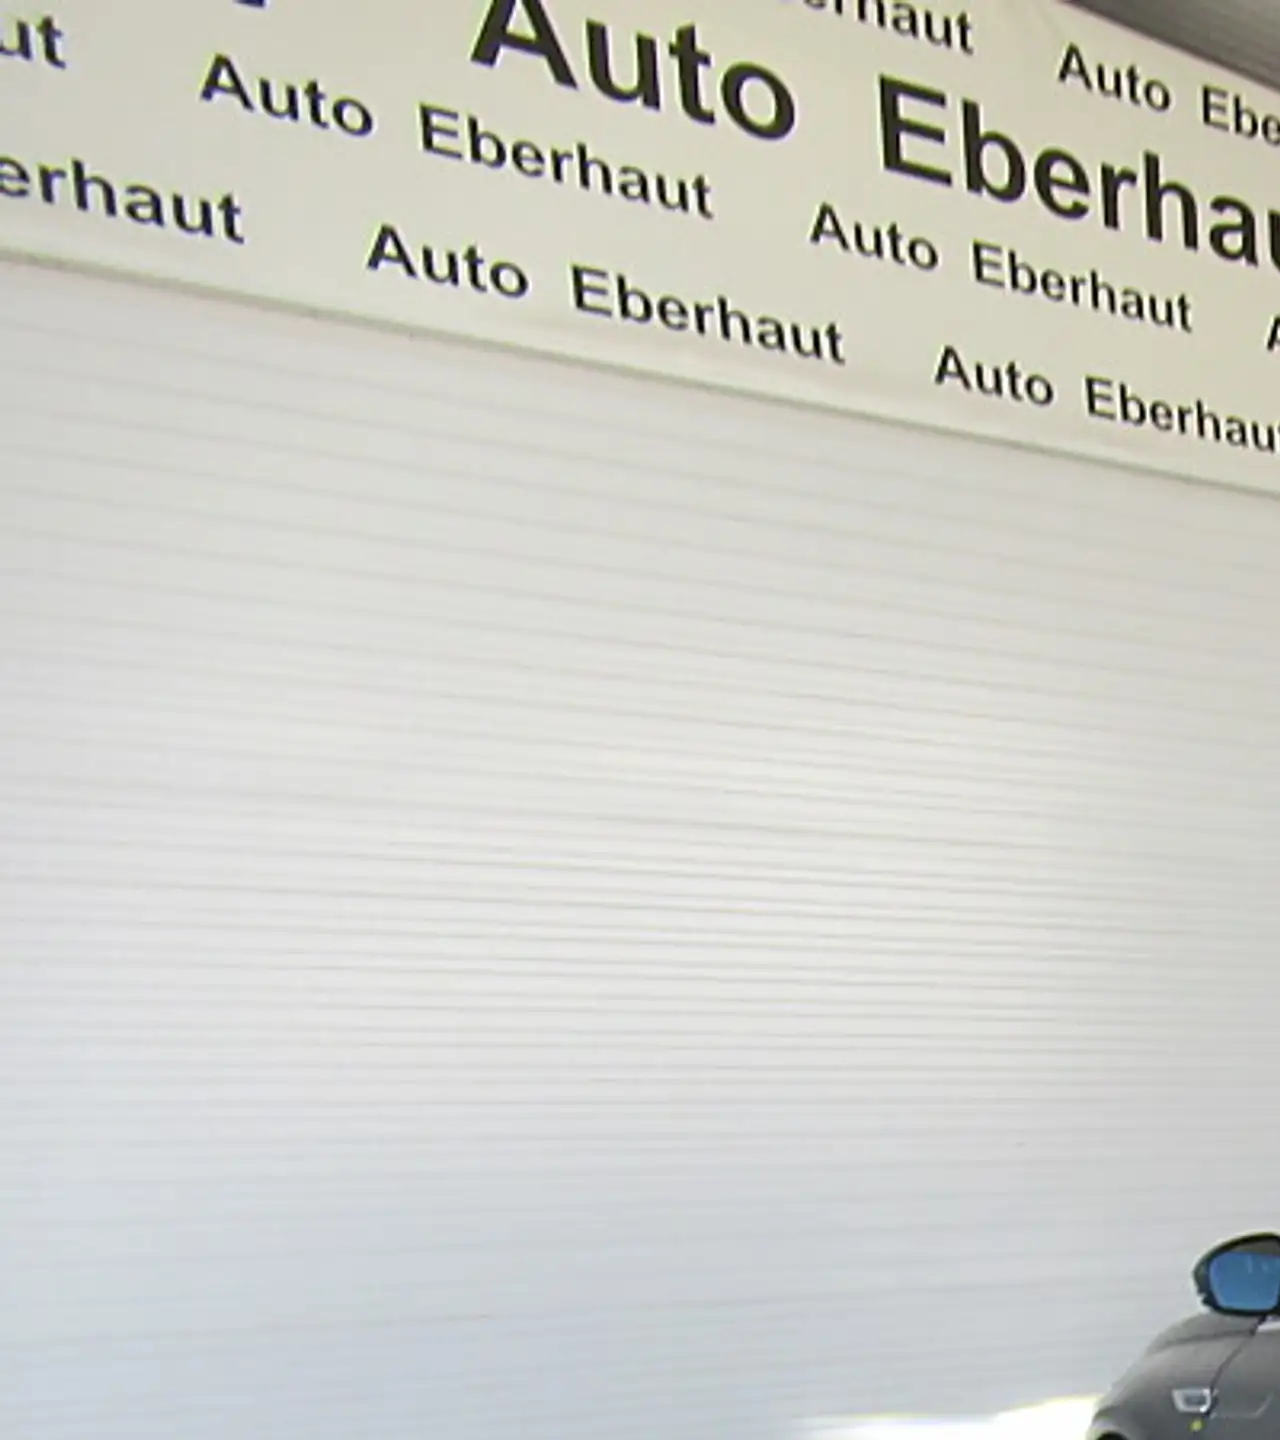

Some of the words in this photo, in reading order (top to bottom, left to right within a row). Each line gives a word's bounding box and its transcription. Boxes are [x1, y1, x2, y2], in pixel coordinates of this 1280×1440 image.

[201, 55, 372, 136] Auto
[420, 103, 715, 218] Eberhaut
[468, 0, 794, 140] Auto
[1059, 44, 1170, 111] Auto
[368, 225, 528, 297] Auto
[573, 265, 844, 363] Eberhaut
[811, 203, 938, 269] Auto
[973, 240, 1193, 332] Eberhaut
[936, 346, 1053, 405] Auto
